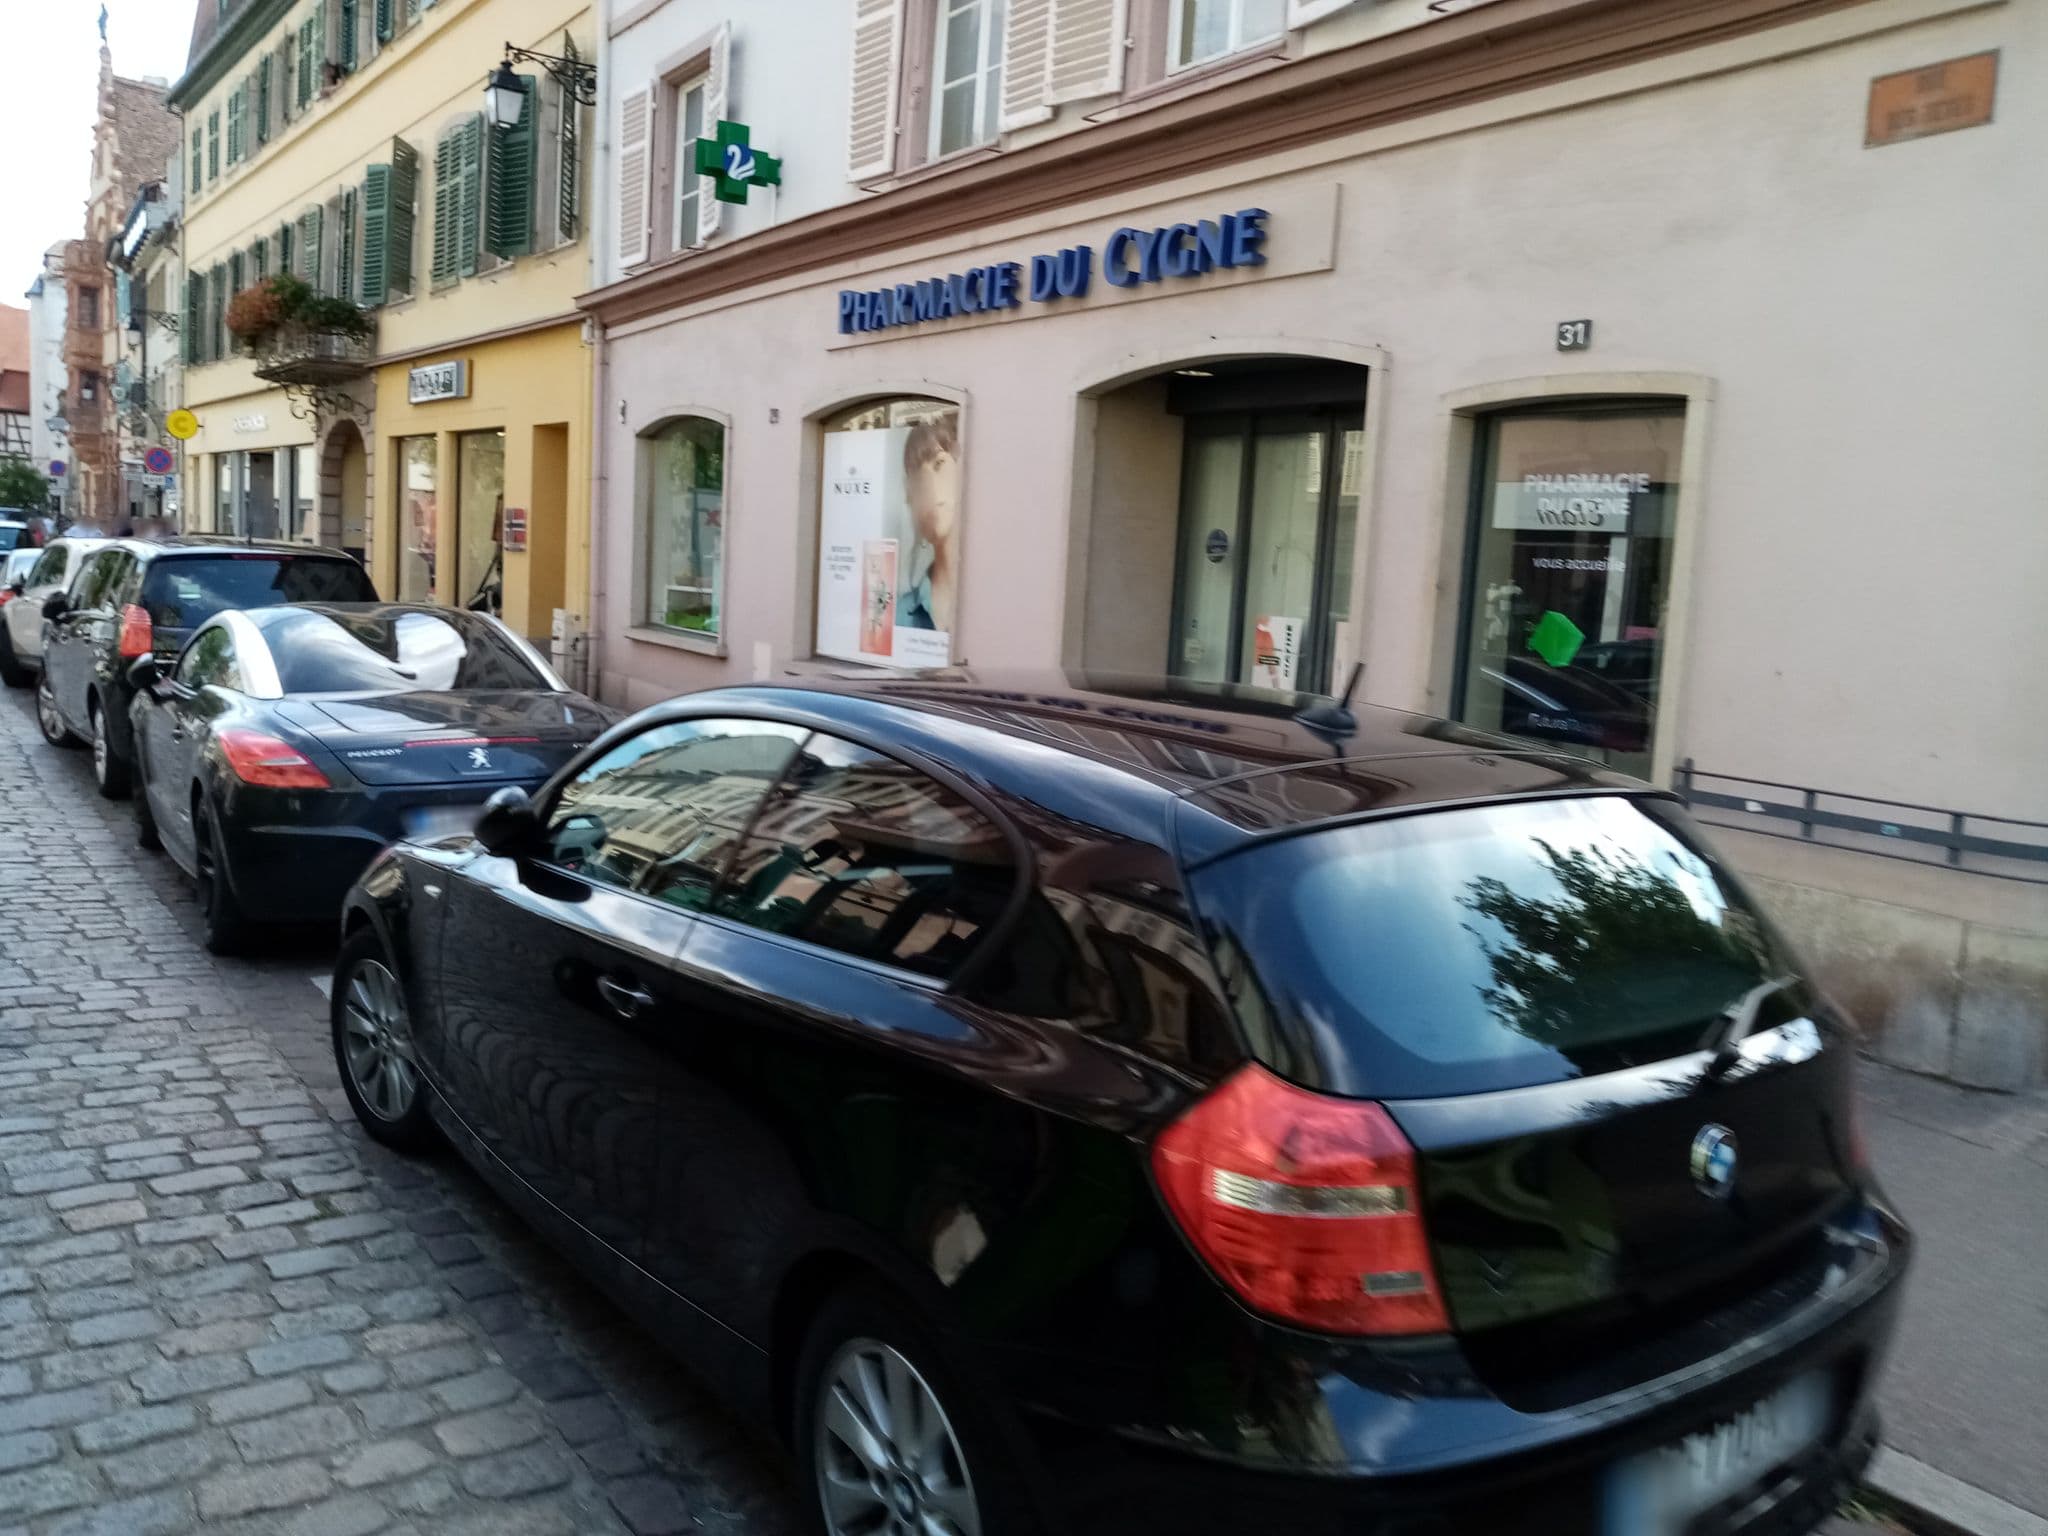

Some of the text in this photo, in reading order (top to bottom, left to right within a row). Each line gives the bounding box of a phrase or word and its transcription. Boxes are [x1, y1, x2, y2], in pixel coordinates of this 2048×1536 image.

[838, 207, 1270, 335] PHARMACIE DU CYGNE
[1559, 322, 1585, 346] 31
[833, 481, 871, 495] NUXE
[1523, 472, 1650, 494] PHARMACIE
[1531, 557, 1565, 569] vous
